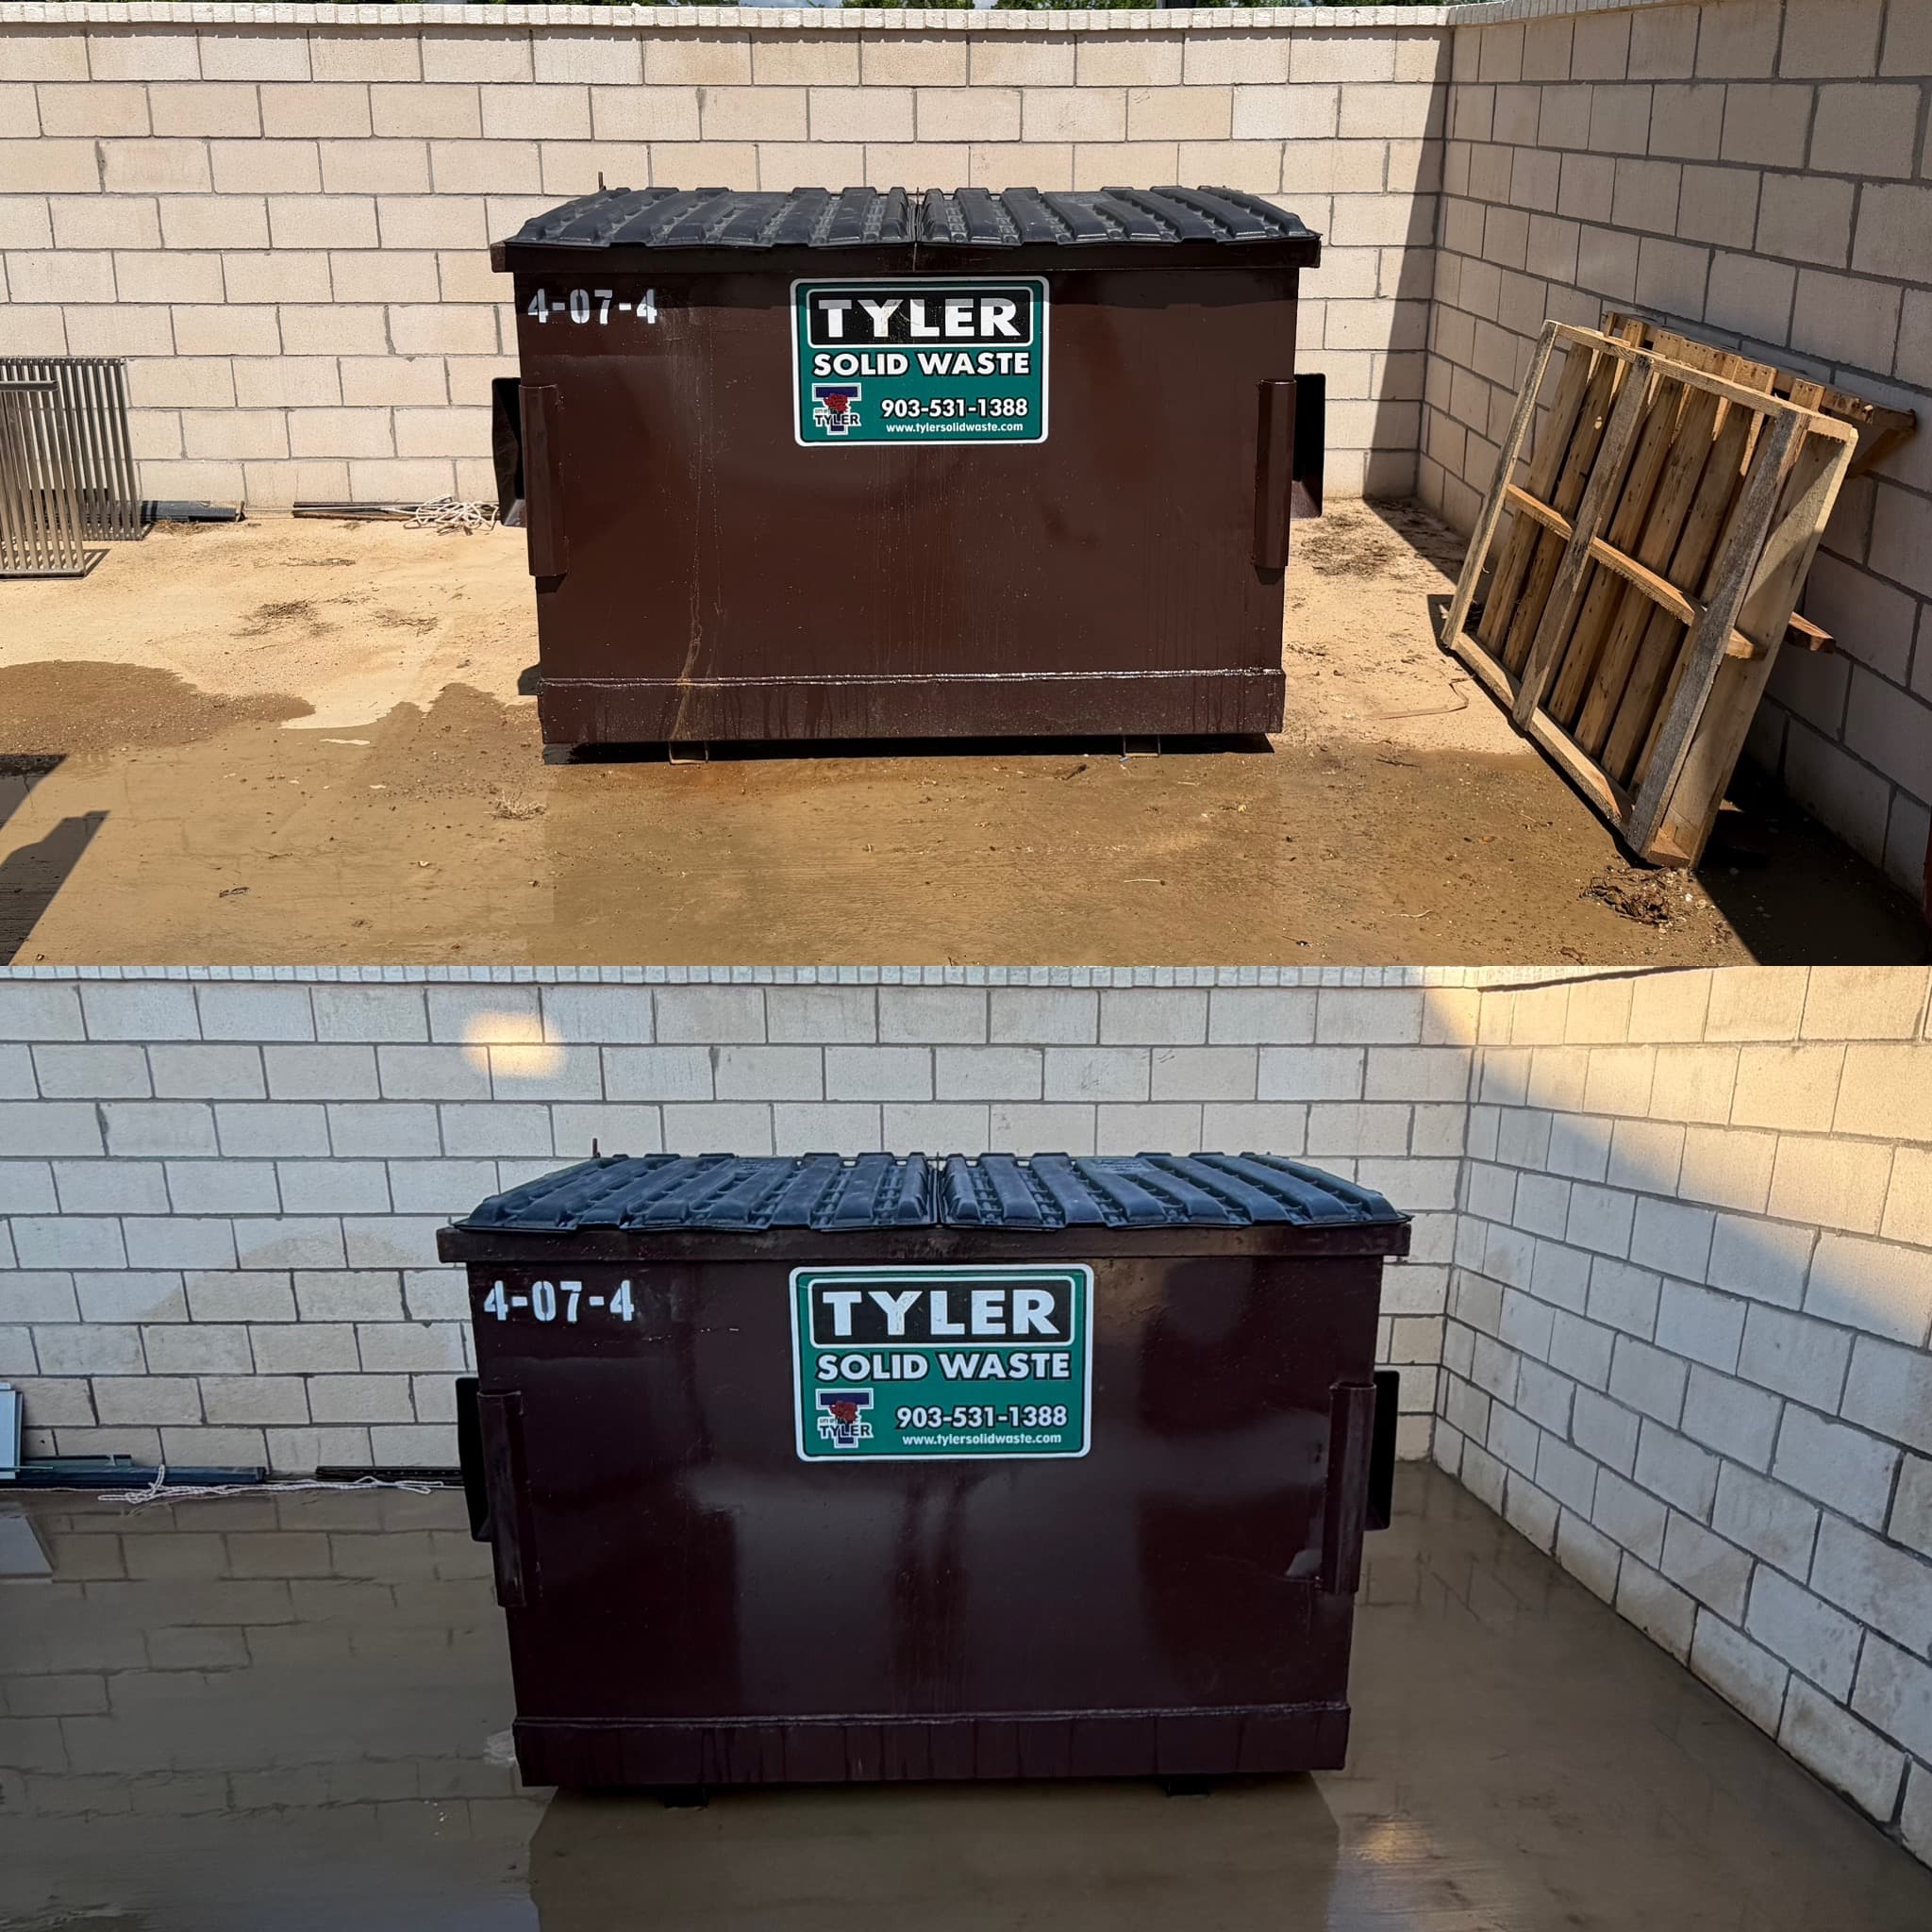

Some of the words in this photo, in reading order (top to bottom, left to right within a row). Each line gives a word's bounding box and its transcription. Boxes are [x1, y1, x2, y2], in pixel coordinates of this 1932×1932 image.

[527, 288, 658, 325] 4-07-4
[818, 297, 1021, 339] TYLER
[813, 352, 908, 376] SOLID
[918, 351, 1030, 375] WASTE
[881, 398, 1028, 417] 903-531-1388
[814, 414, 860, 426] TYLER
[887, 422, 1024, 434] www.tylersolidwaste.com
[483, 1279, 635, 1322] 4-07-4
[822, 1289, 1059, 1336] TYLER
[816, 1354, 928, 1380] SOLID
[939, 1353, 1070, 1379] WASTE
[897, 1406, 1067, 1428] 903-531-1388
[819, 1424, 871, 1438] TYLER
[902, 1433, 1061, 1446] www.tylersolidwaste.com
